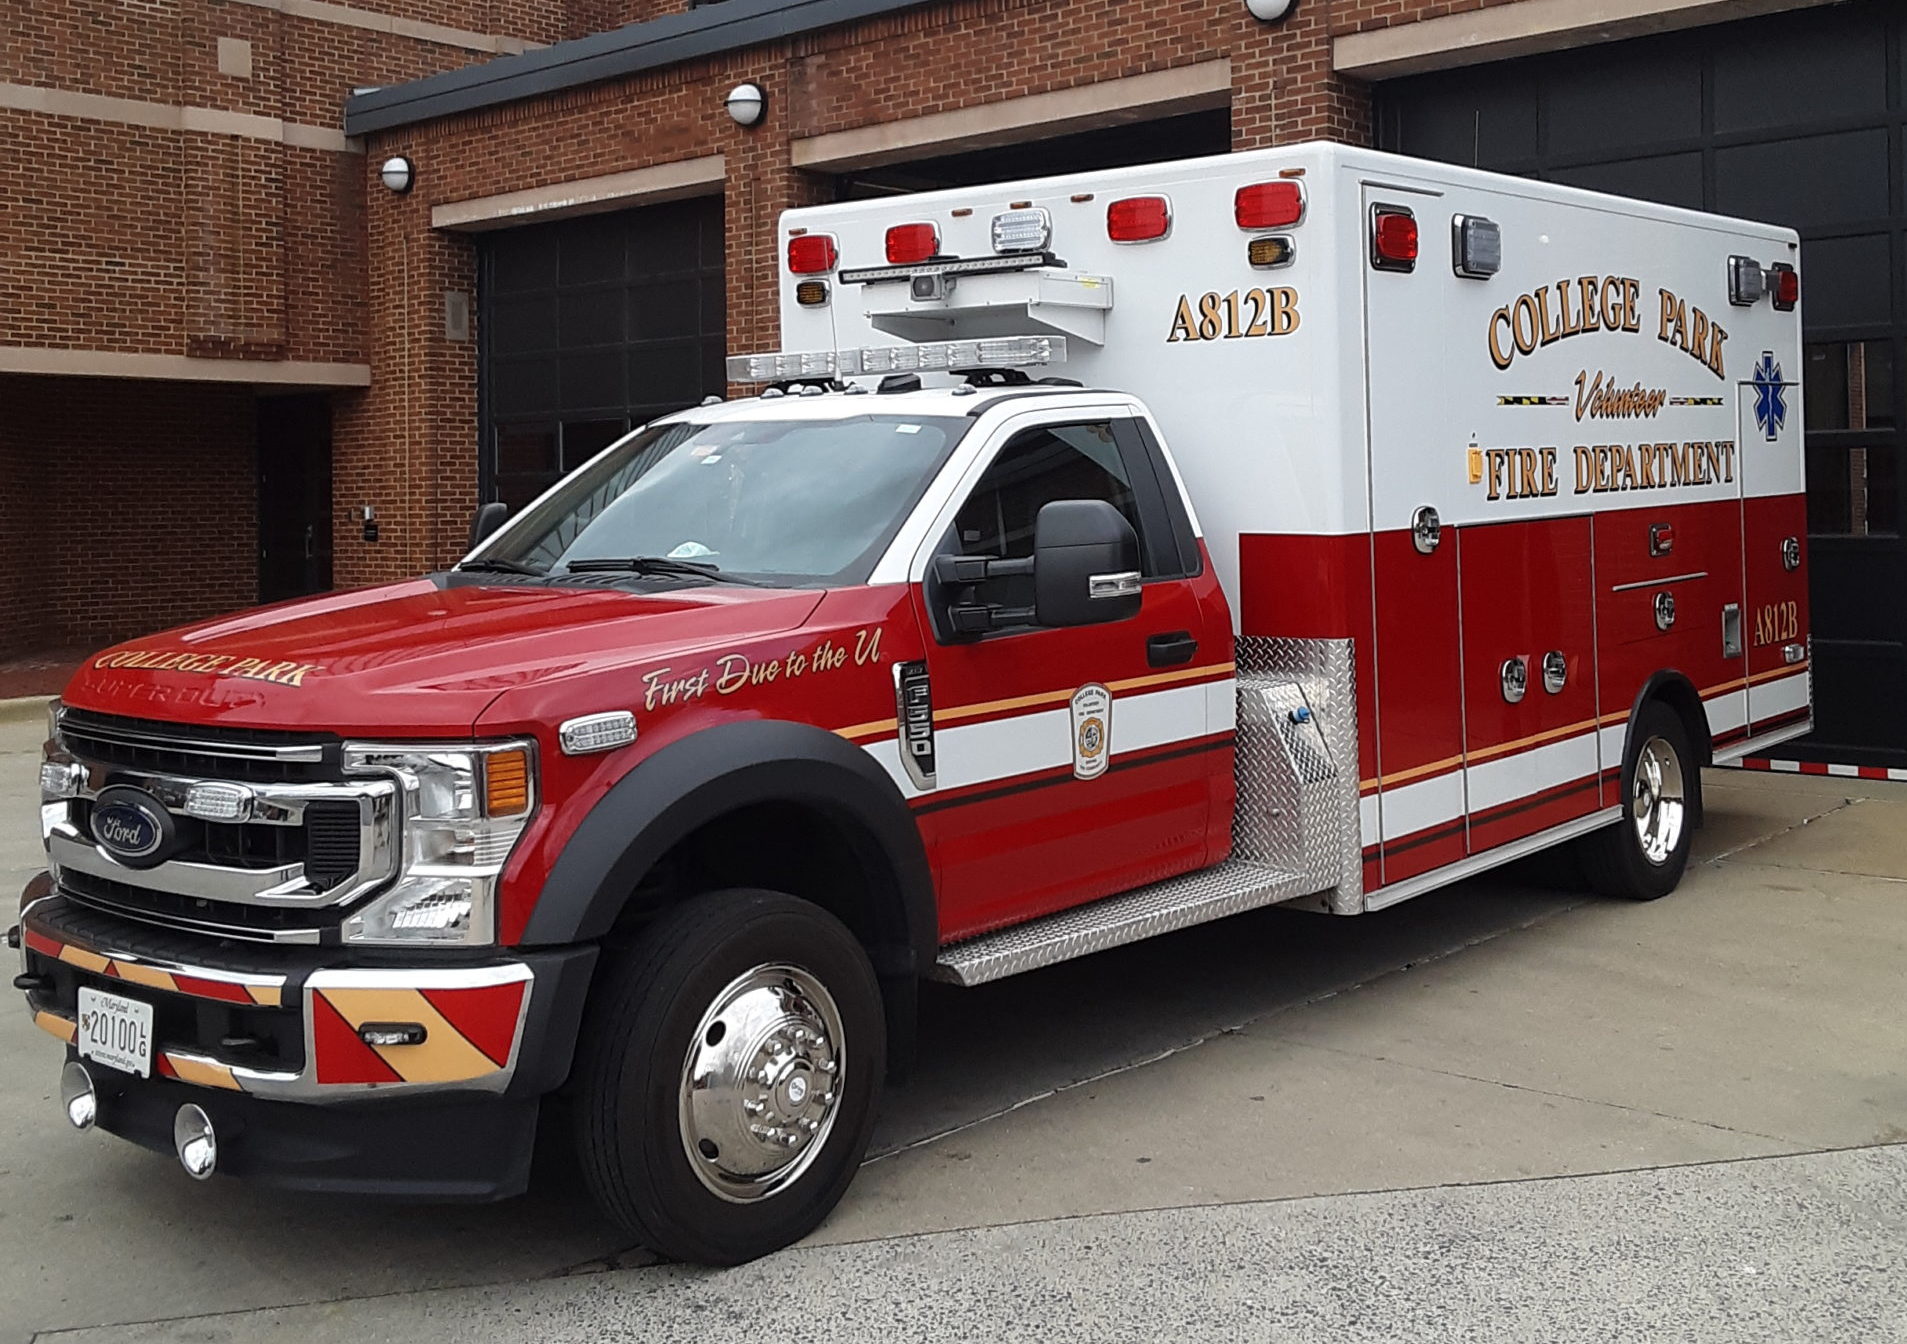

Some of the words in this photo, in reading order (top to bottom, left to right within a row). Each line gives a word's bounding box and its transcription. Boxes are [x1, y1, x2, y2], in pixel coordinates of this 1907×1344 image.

[1166, 286, 1301, 342] A812B
[1487, 275, 1640, 370] COLLEGE
[1658, 288, 1728, 381] PARK
[1574, 370, 1666, 422] Volunteer
[1486, 447, 1558, 500] FIRE
[1574, 440, 1735, 494] DEPARTMENT
[1753, 601, 1798, 646] A812B
[93, 651, 225, 674] COLLEGE
[217, 656, 326, 687] PARK
[642, 667, 709, 711] First
[716, 653, 782, 695] Due
[786, 650, 809, 678] to
[812, 640, 848, 673] the
[855, 627, 882, 666] U
[103, 815, 142, 845] Ford
[90, 1010, 137, 1054] 20100
